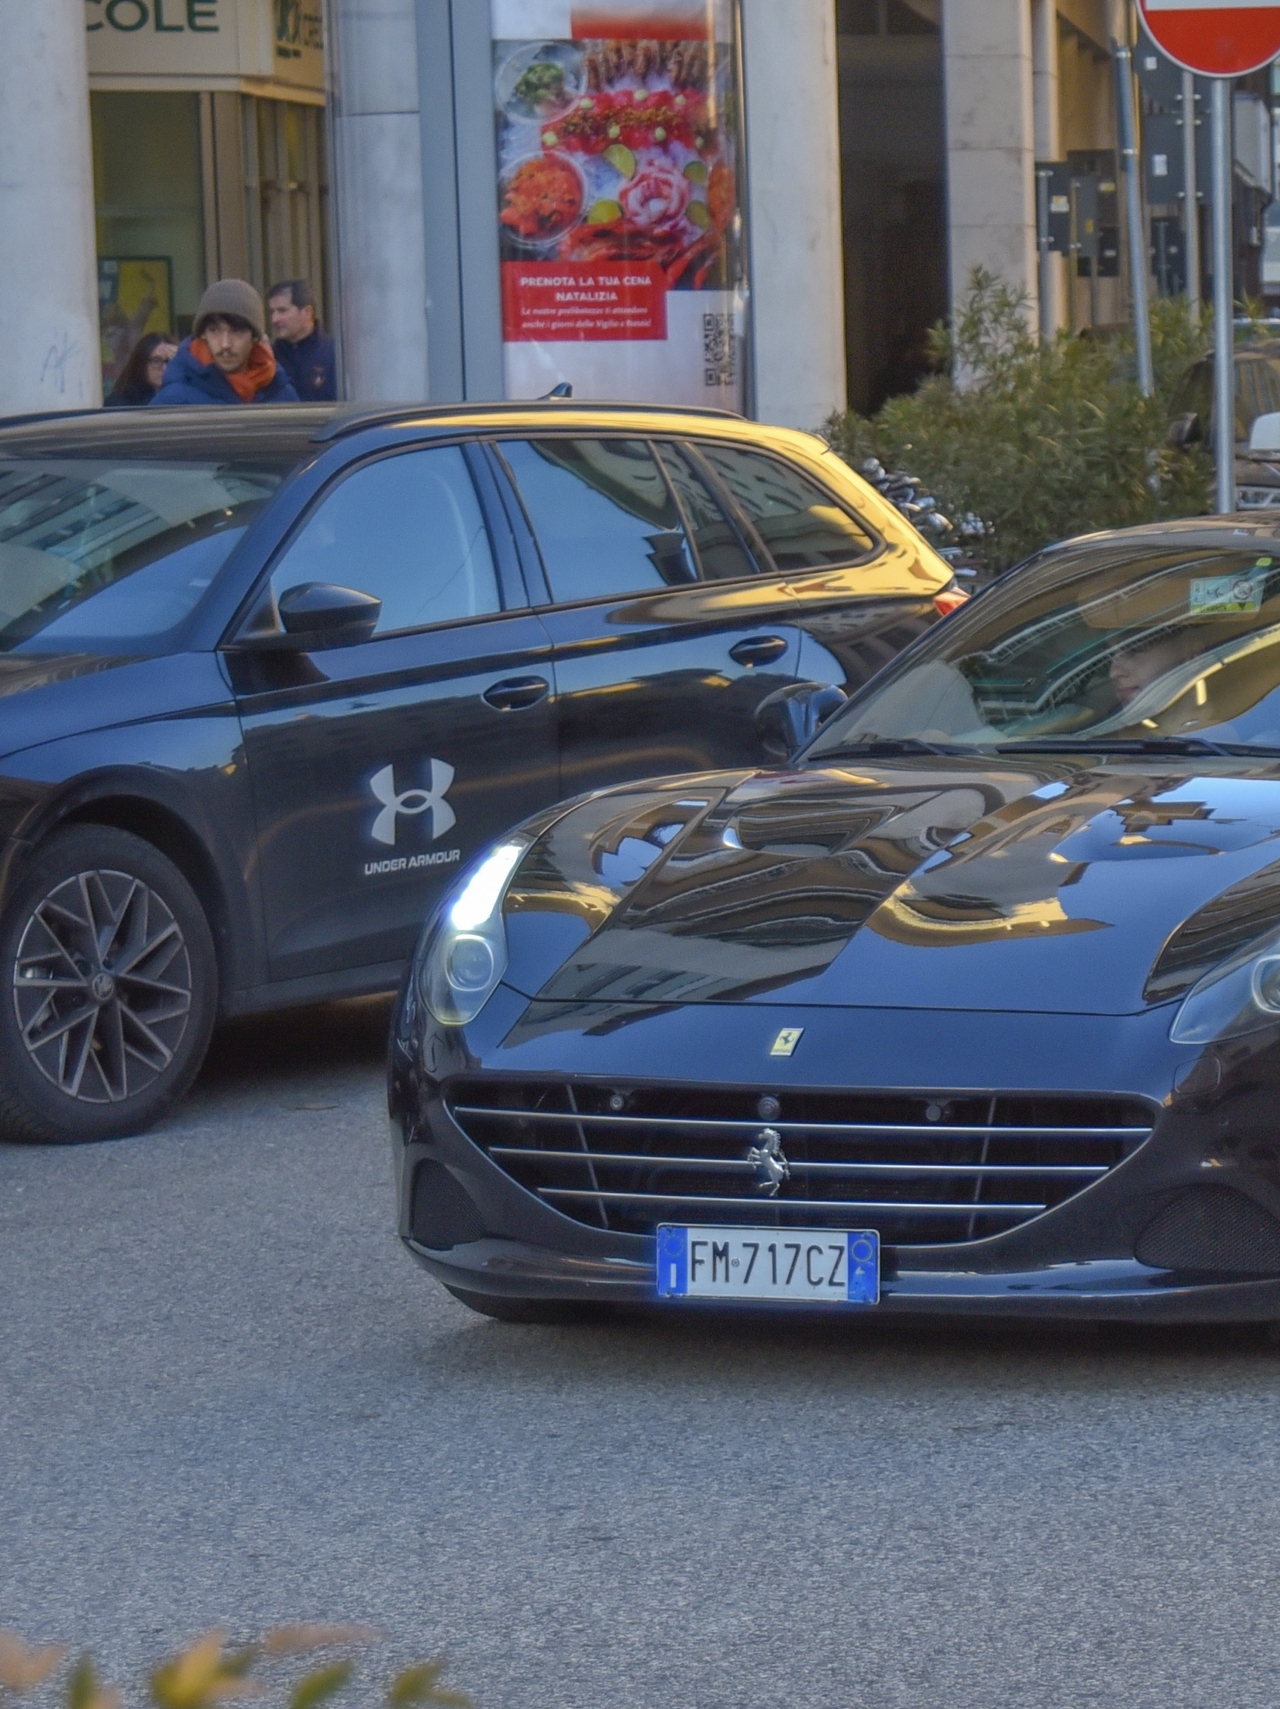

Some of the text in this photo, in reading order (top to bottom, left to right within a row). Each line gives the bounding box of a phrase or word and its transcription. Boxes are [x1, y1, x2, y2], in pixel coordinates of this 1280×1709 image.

[520, 276, 652, 287] PRENOTA LA TUA CENA
[556, 291, 618, 301] NATALIZIA
[364, 849, 460, 876] UNDER ARMOUR
